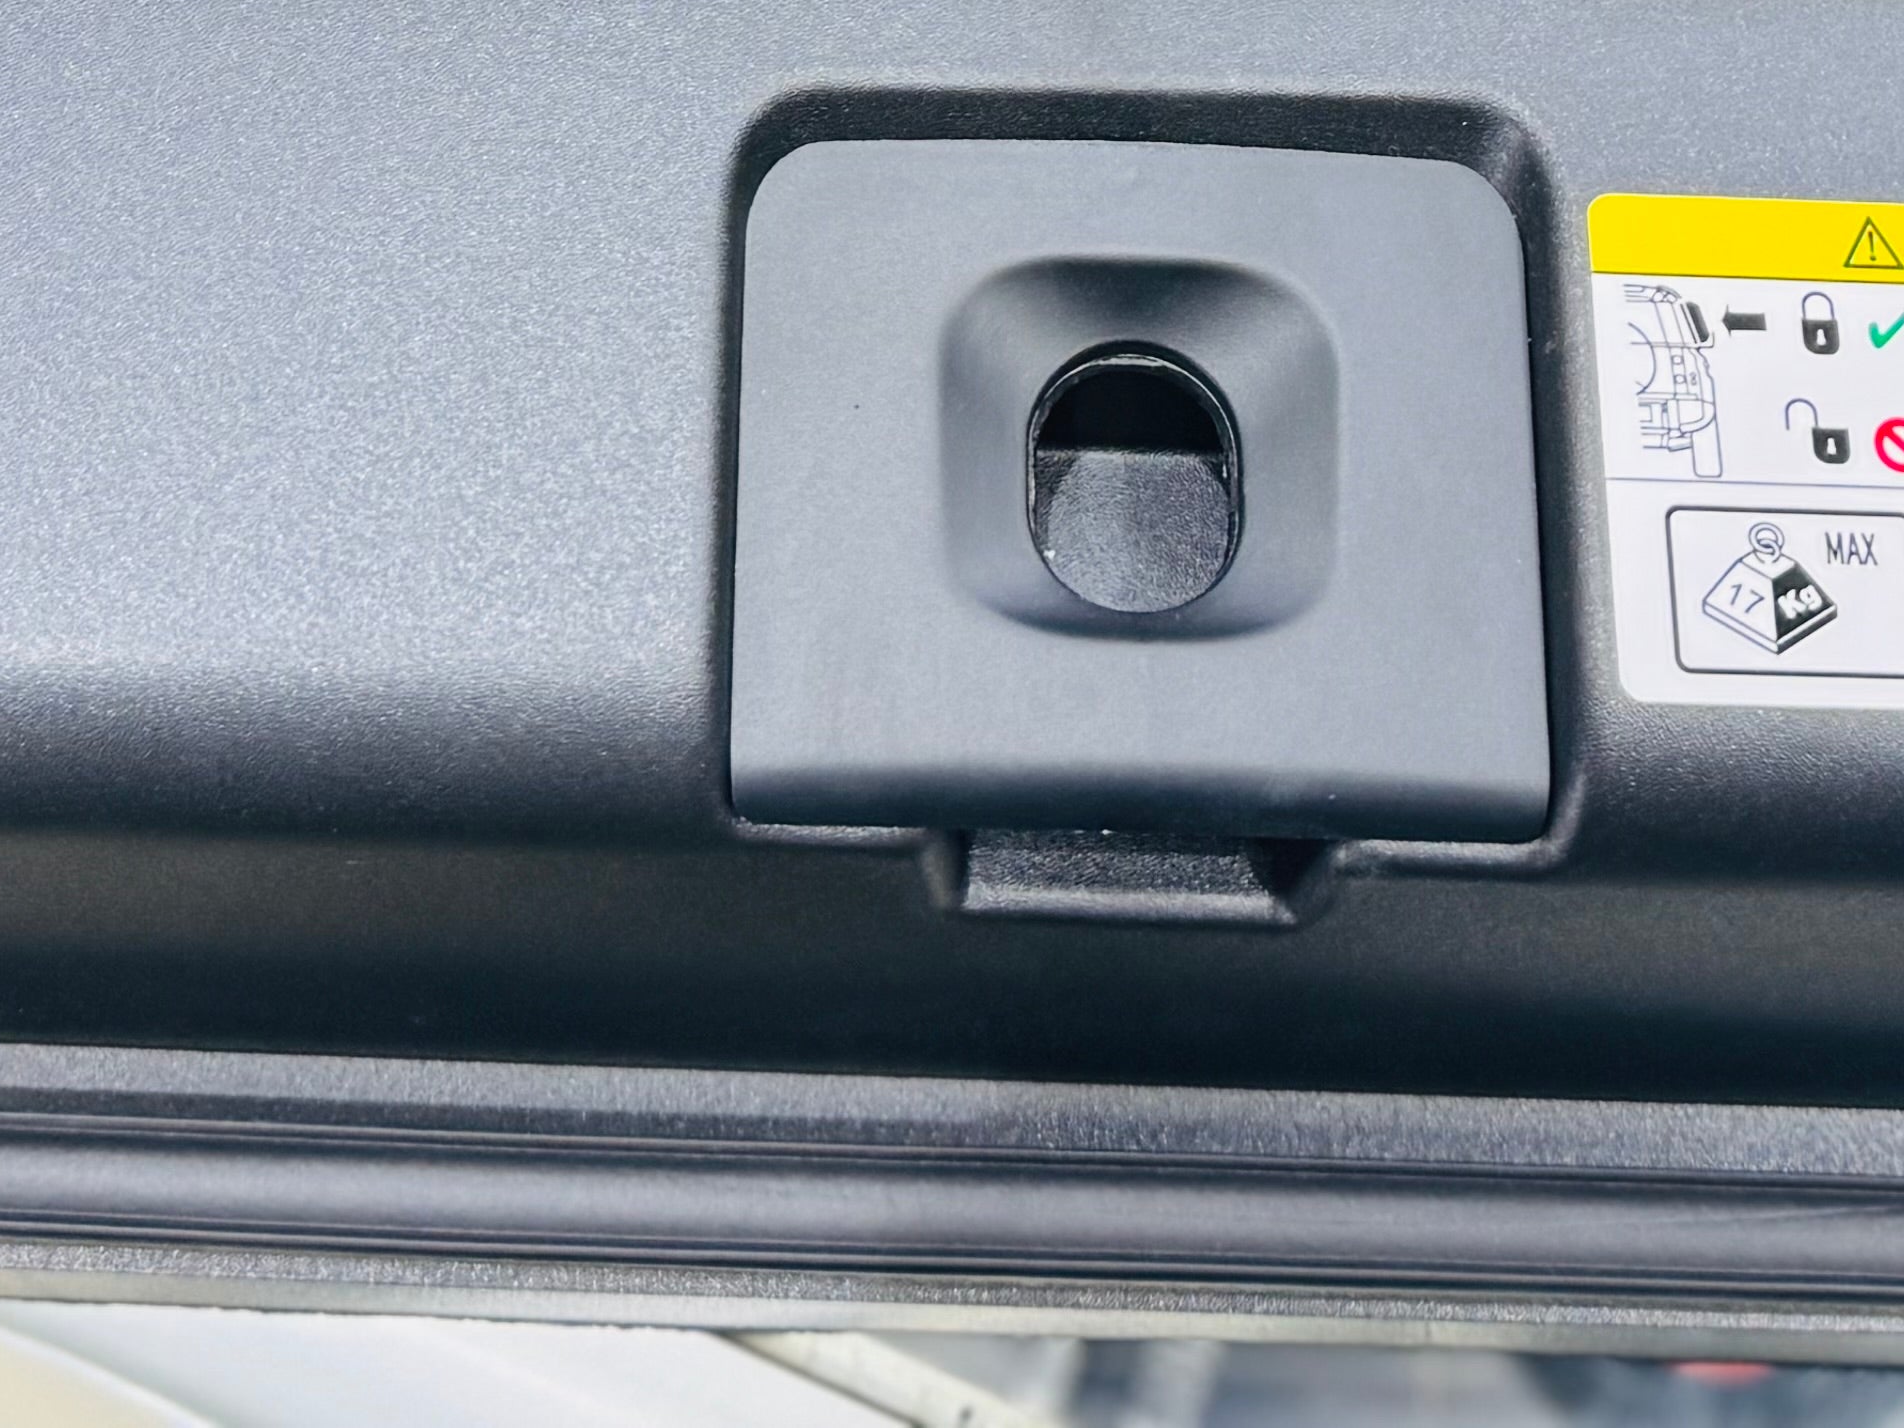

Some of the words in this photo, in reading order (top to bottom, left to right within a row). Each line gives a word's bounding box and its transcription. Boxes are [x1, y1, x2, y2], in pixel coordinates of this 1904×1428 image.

[1825, 531, 1878, 566] MAX
[1731, 584, 1765, 614] 17
[1777, 585, 1823, 619] Kg
